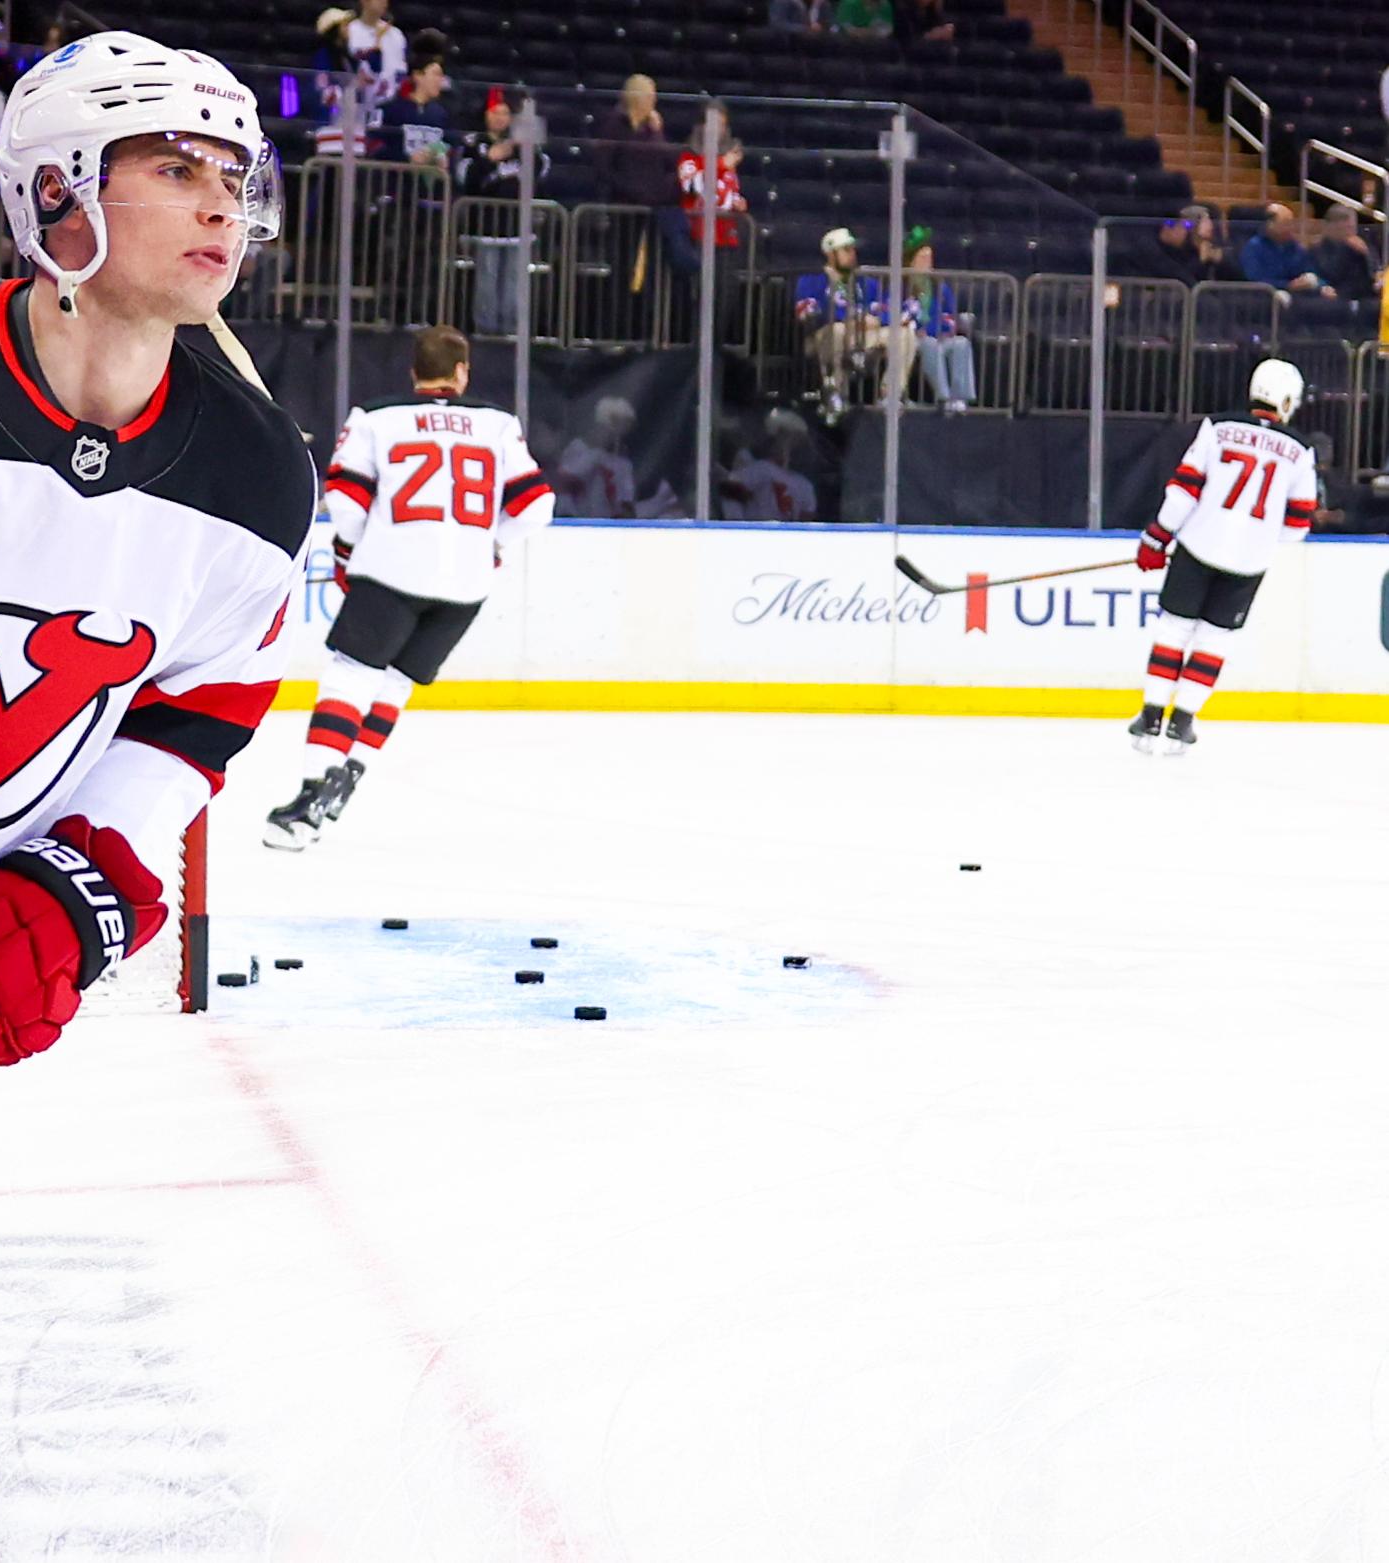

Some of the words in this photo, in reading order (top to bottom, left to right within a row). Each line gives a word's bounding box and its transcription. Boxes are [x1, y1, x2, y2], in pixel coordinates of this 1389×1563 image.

[414, 413, 473, 436] MEIER
[389, 441, 495, 529] 28
[1220, 448, 1277, 520] 71
[732, 573, 941, 625] Michelob
